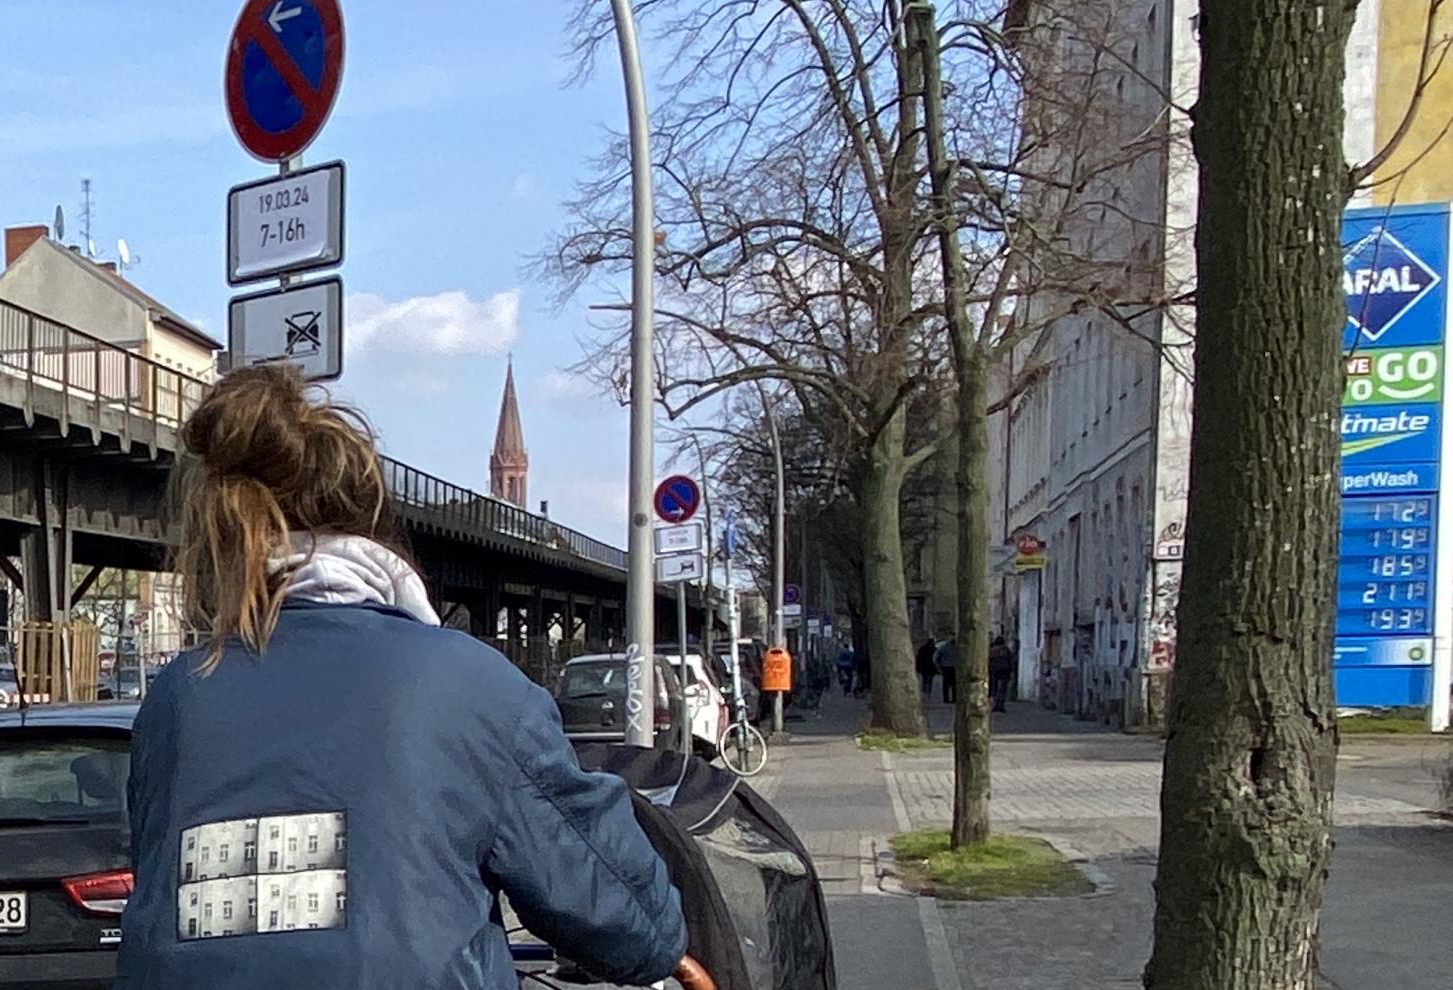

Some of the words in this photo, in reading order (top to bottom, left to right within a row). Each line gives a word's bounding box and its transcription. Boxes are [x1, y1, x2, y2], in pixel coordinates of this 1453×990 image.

[259, 185, 309, 214] 19.03.24
[260, 217, 305, 248] 7-16h
[1377, 350, 1437, 382] GO
[1341, 411, 1430, 434] timate
[1341, 470, 1418, 492] perWash
